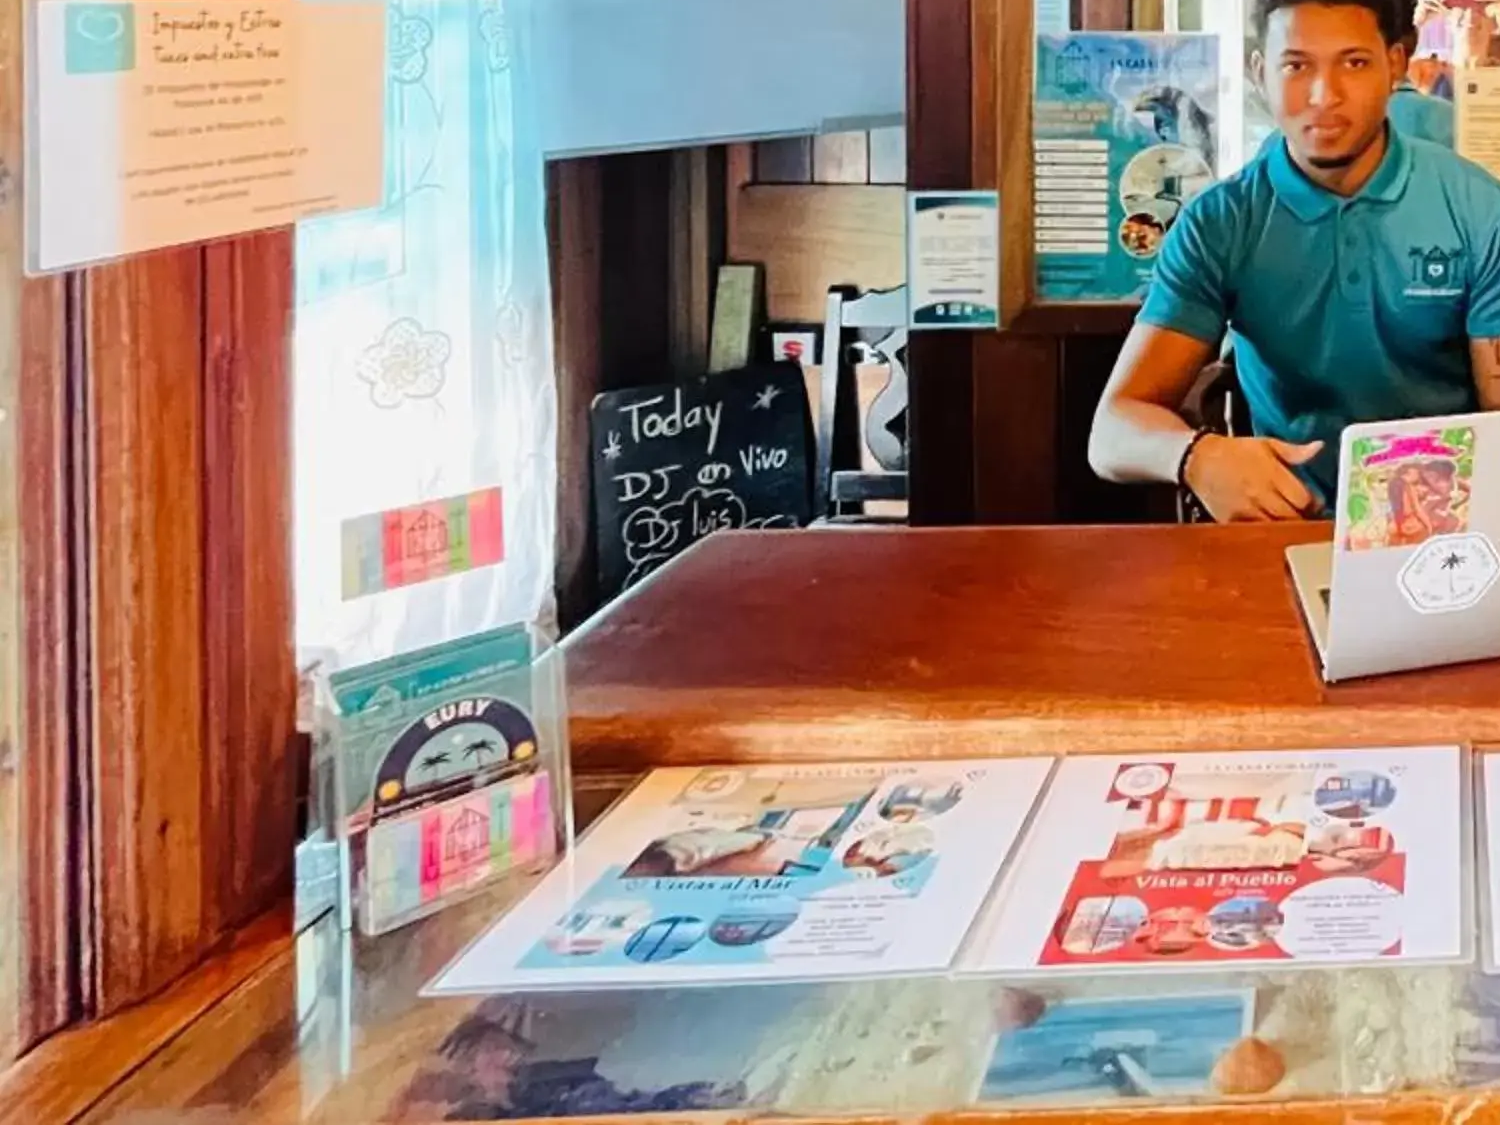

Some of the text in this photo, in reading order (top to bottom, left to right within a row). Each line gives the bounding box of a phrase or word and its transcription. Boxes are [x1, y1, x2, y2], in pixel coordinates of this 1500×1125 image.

[618, 388, 722, 455] Today
[423, 698, 494, 731] EURY
[1135, 872, 1297, 890] Vista al Pueblo
